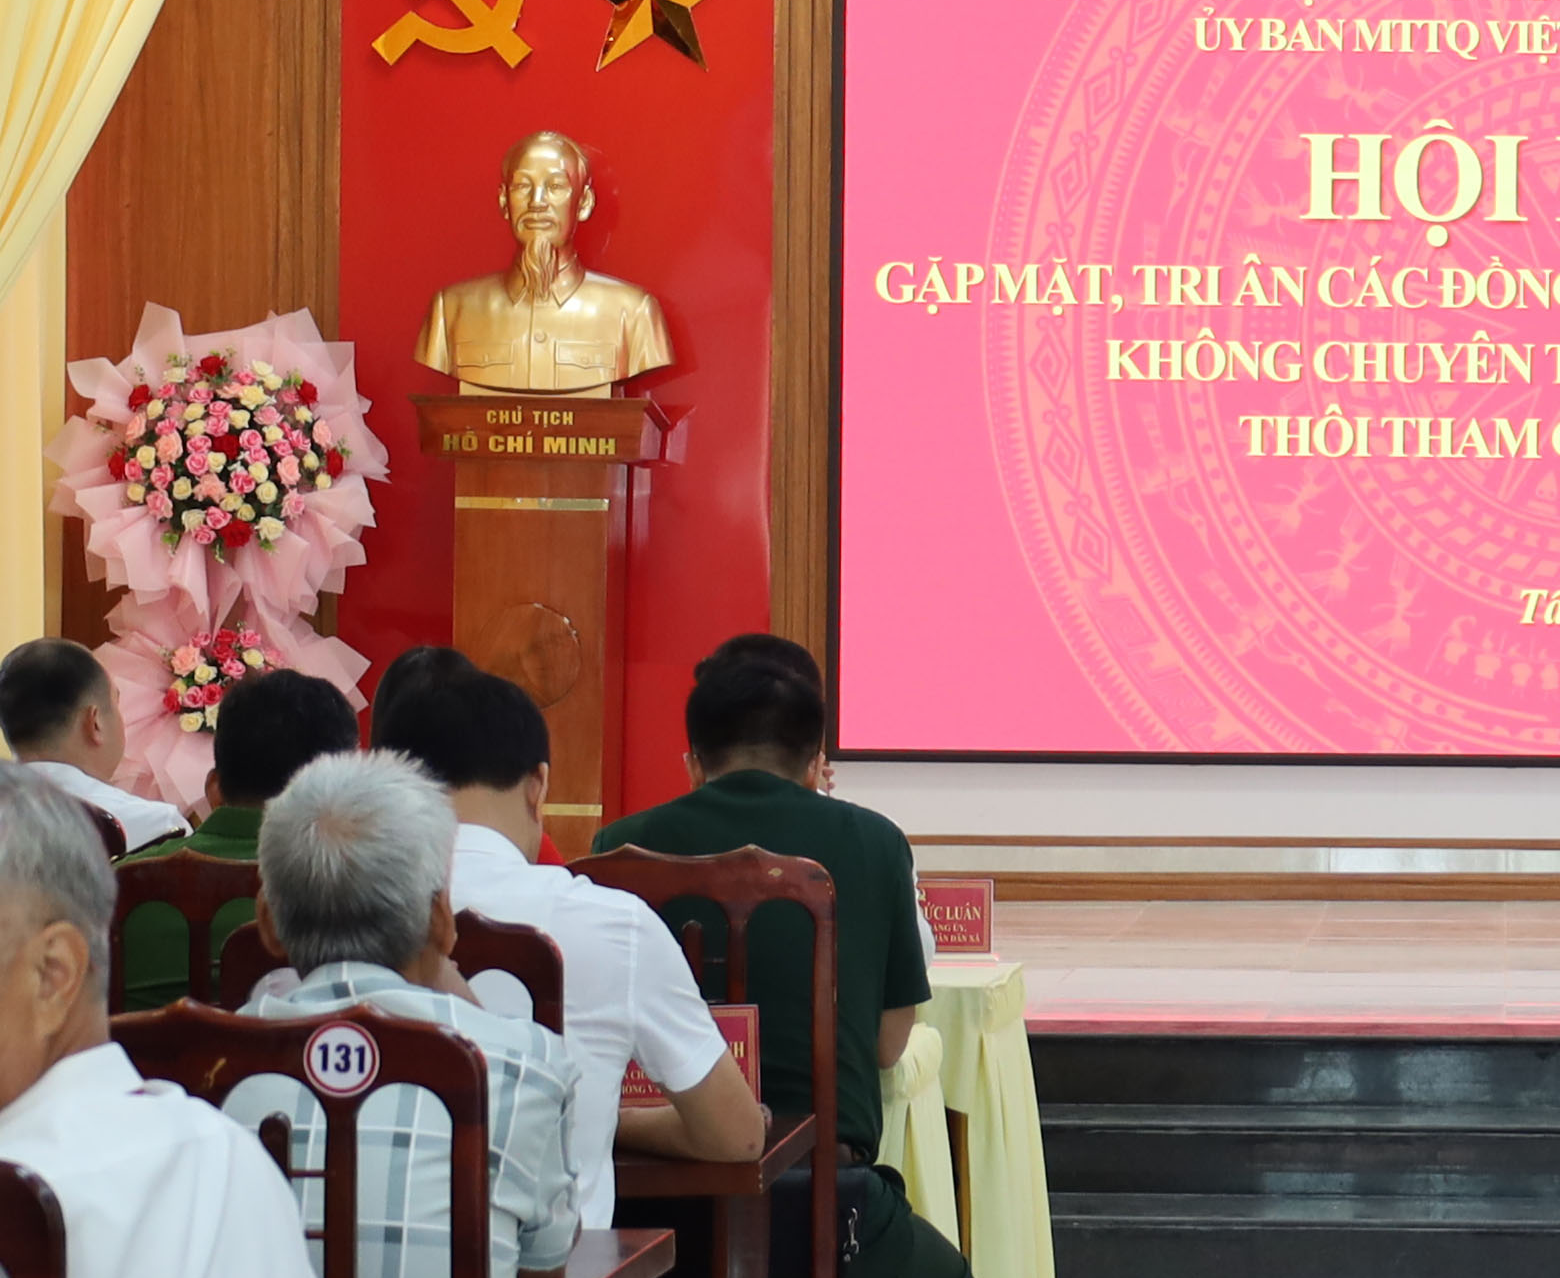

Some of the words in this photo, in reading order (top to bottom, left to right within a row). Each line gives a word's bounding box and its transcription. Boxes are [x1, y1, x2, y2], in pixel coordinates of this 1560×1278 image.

[1194, 7, 1253, 50] ỦY
[1259, 18, 1345, 51] BAN
[1353, 19, 1479, 59] MTTQ
[1299, 119, 1528, 246] HỘI
[876, 257, 984, 314] GẶP
[992, 257, 1123, 315] MẶT,
[1133, 265, 1221, 305] TRI
[1232, 257, 1306, 306] ÂN
[1318, 258, 1428, 308] CÁC
[1107, 327, 1302, 381] KHÔNG
[1313, 330, 1533, 383] CHUYÊN
[443, 426, 479, 452] HỒ
[488, 431, 534, 454] CHÍ
[543, 435, 617, 456] MINH
[486, 405, 523, 424] CHỦ
[532, 411, 574, 428] TỊCH
[1239, 405, 1371, 457] THÔI
[1381, 417, 1540, 458] THAM
[318, 1043, 366, 1074] 131
